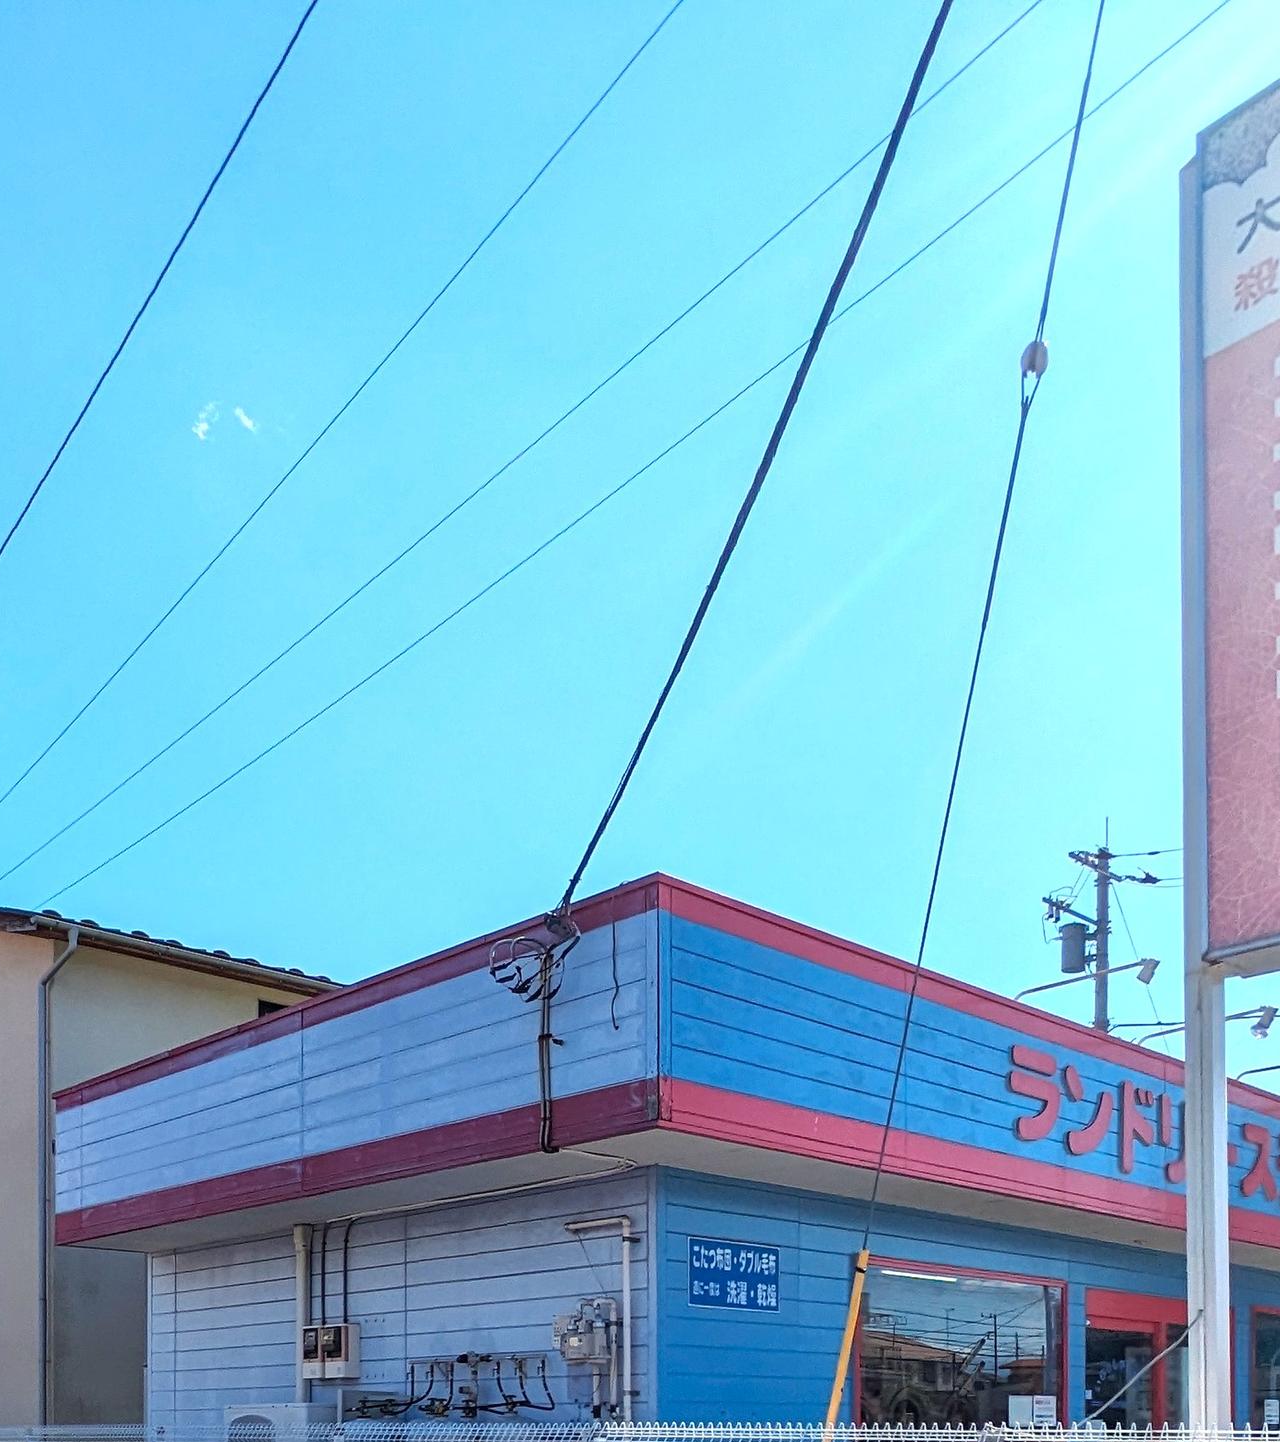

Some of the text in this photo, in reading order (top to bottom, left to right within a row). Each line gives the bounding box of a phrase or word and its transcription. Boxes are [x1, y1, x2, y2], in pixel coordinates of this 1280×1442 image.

[692, 1245, 777, 1275] こたつ布団・ダブル毛布
